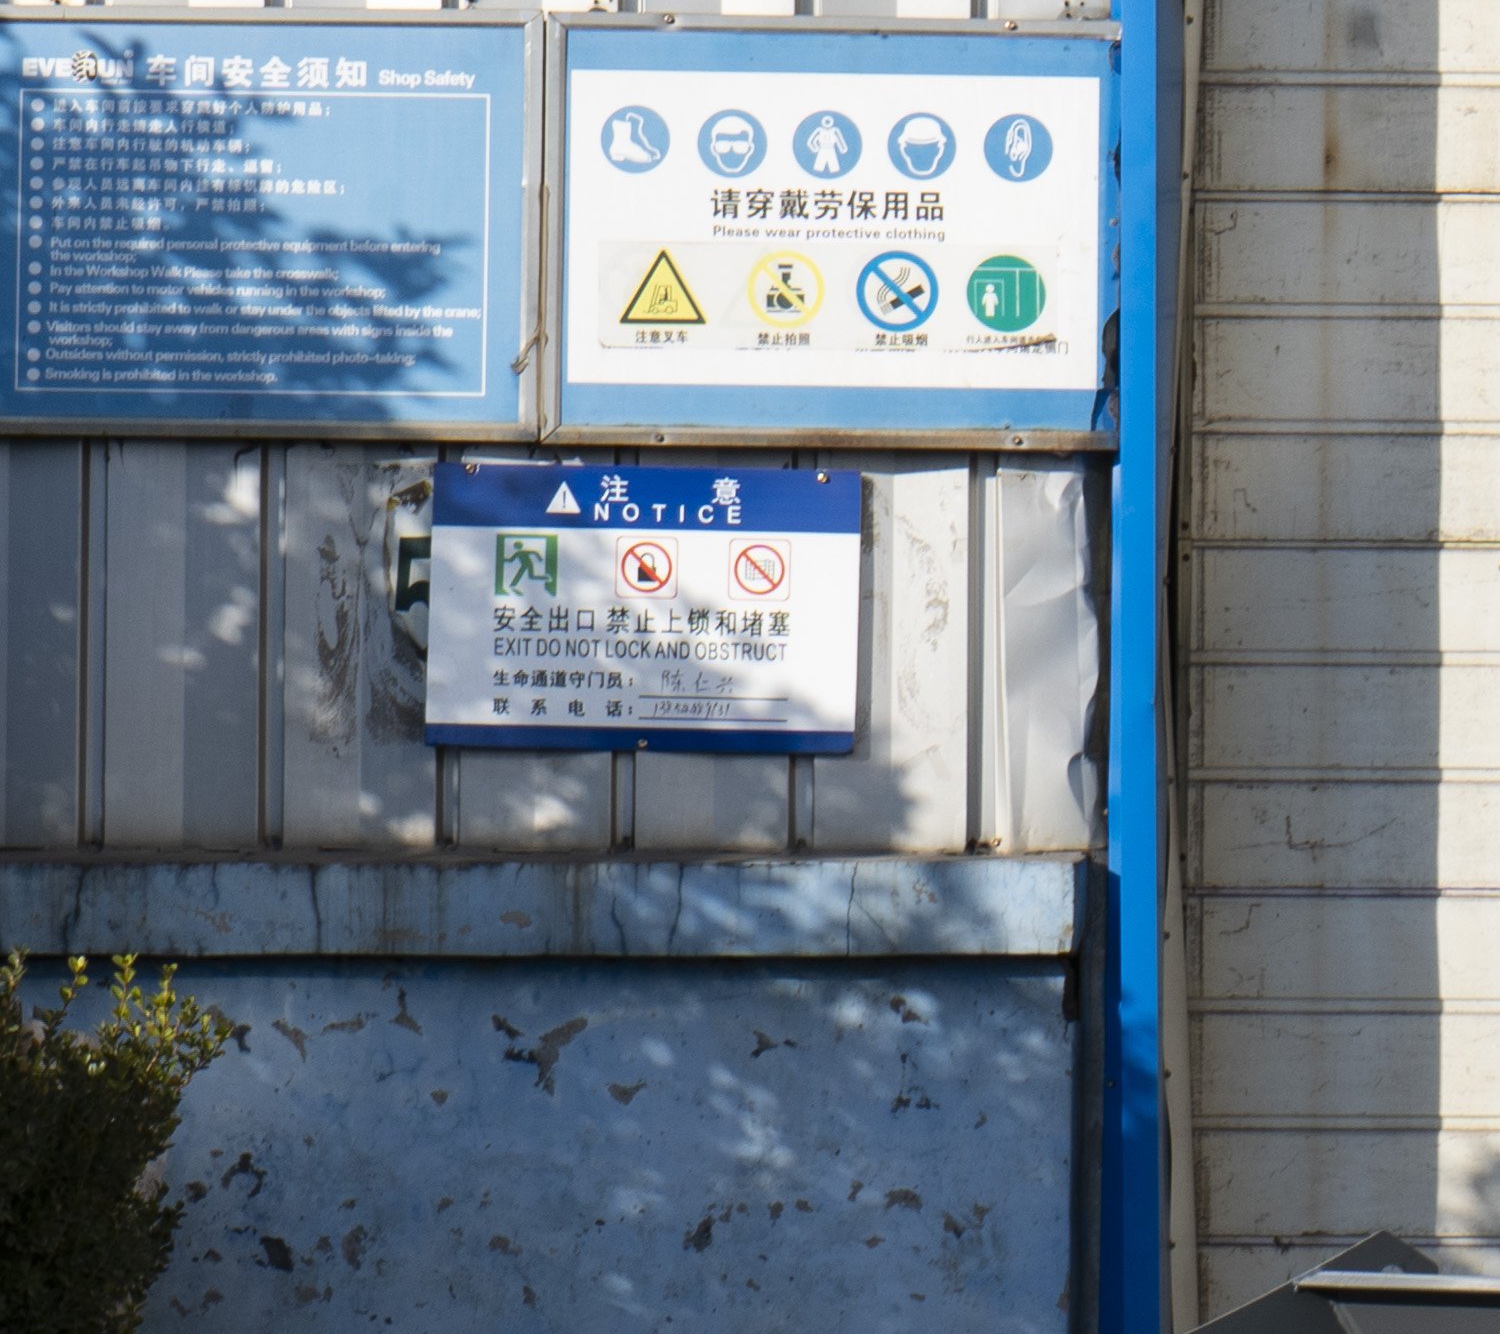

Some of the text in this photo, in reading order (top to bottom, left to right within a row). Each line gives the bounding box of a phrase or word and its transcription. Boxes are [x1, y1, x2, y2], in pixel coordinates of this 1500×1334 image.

[22, 50, 475, 89] EVERUN 车间安全须知 Shop Safety
[710, 188, 944, 221] 请穿戴劳保用品
[713, 225, 946, 242] Please wear protective clothing
[51, 237, 441, 255] Put on the required personal protective equipment before entering
[51, 250, 71, 262] the
[51, 266, 62, 277] In
[64, 266, 84, 277] the
[86, 266, 149, 279] Workshop
[151, 267, 182, 278] Walk
[184, 267, 222, 279] Please
[225, 268, 251, 279] take
[253, 268, 274, 279] the
[51, 282, 73, 296] Pay
[74, 283, 129, 295] attention
[131, 284, 144, 295] to
[146, 284, 186, 296] motor
[188, 285, 234, 297] vehicles
[236, 286, 283, 299] running
[286, 285, 297, 297] in
[300, 286, 320, 297] the
[50, 301, 58, 313] It
[60, 301, 70, 313] is
[72, 301, 111, 315] strictly
[114, 302, 178, 316] prohibited
[180, 303, 191, 314] to
[193, 303, 223, 315] walk
[225, 305, 240, 315] or
[240, 304, 267, 318] stay
[268, 304, 303, 316] under
[306, 305, 326, 317] the
[328, 305, 371, 319] objects
[372, 305, 403, 317] lifted
[404, 305, 420, 320] by
[422, 305, 443, 318] the
[46, 320, 454, 338] Visitors should stay away from dangerous areas with signs inside the
[635, 330, 688, 344] 注意叉车
[758, 332, 811, 346] 禁止拍照
[875, 333, 928, 347] 禁止吸烟
[46, 347, 103, 360] Outsiders
[105, 349, 154, 362] without
[227, 351, 268, 364] strictly
[268, 351, 331, 364] prohibited
[46, 367, 100, 383] Smoking
[102, 369, 112, 380] is
[114, 369, 176, 382] prohibited
[179, 370, 190, 381] in
[192, 370, 213, 381] the
[600, 474, 741, 505] 注意
[594, 503, 742, 525] NOTICE
[493, 604, 791, 637] 安全出口 禁止上锁和堵塞
[494, 636, 788, 661] EXIT DO NOT LOCK AND OBSTRUCT
